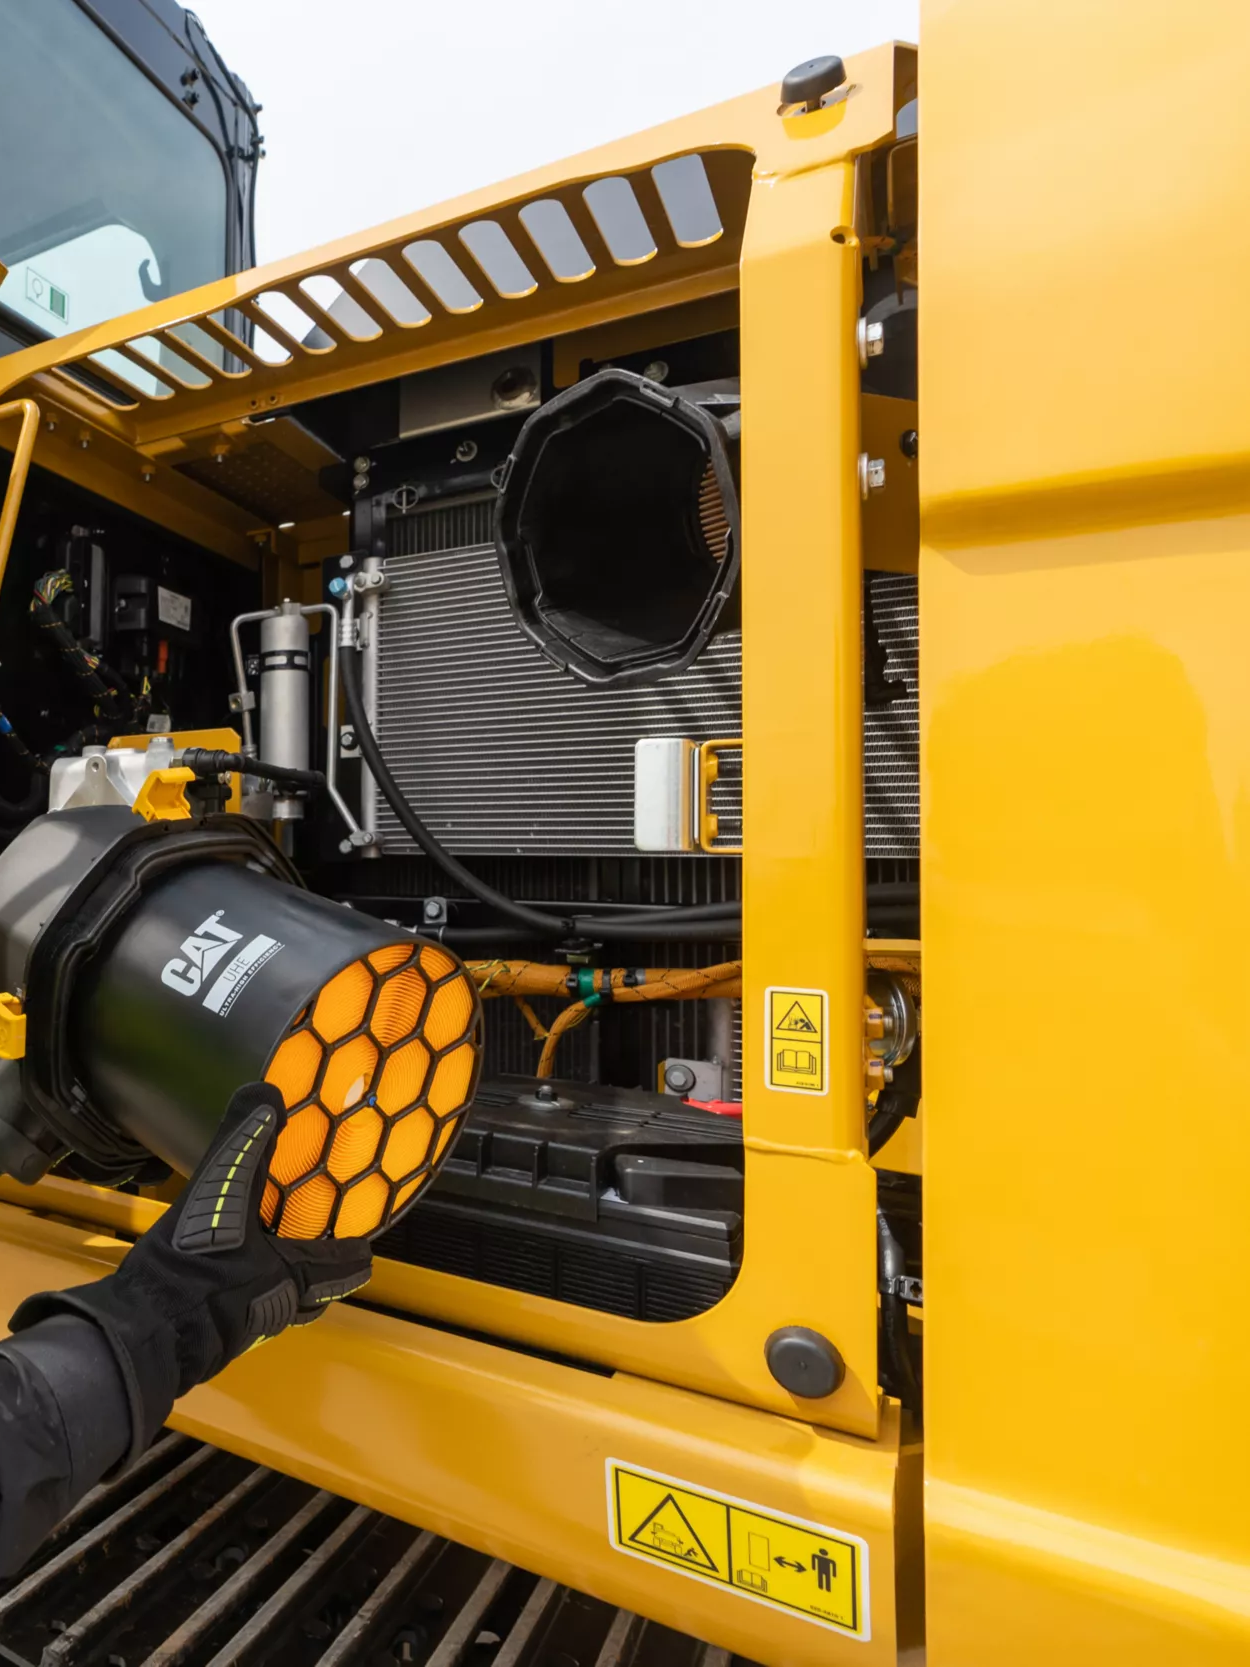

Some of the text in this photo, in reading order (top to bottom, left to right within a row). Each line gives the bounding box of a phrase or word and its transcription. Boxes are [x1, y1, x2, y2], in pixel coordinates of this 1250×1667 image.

[160, 912, 244, 997] CAT
[218, 941, 283, 1017] ULTRA-HIGH EFFICIENCY
[222, 956, 251, 983] UHE
